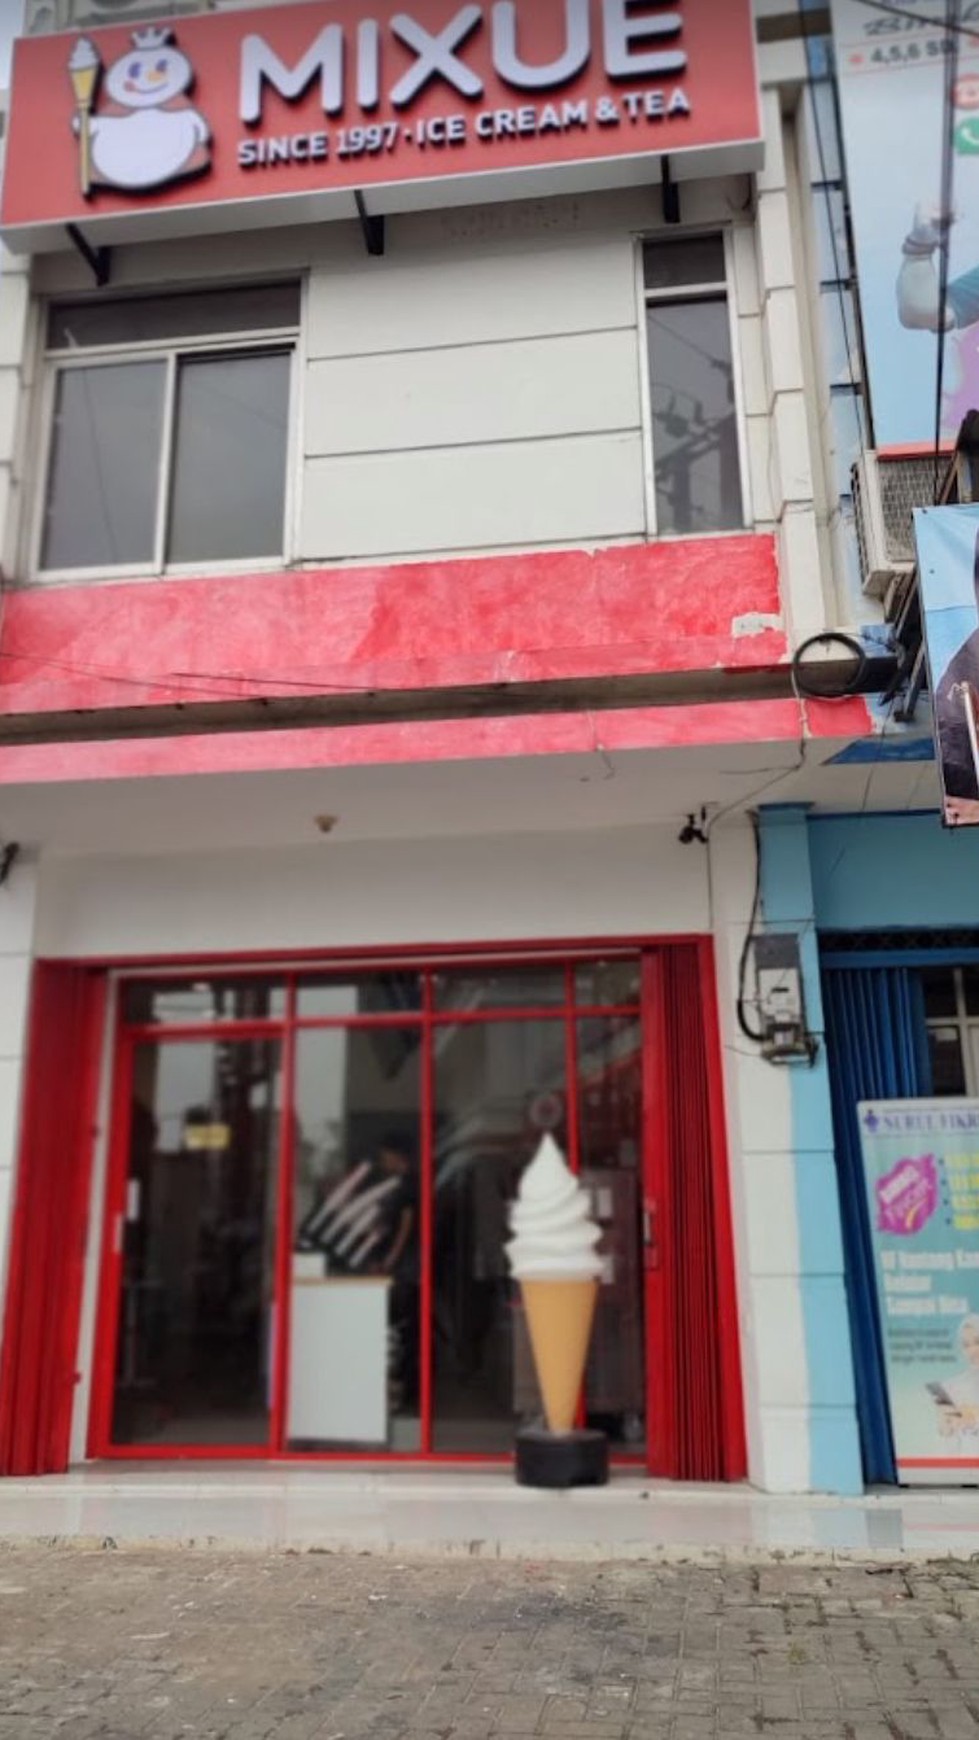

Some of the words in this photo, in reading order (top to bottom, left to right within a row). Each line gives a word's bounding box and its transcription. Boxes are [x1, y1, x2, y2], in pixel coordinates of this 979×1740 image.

[240, 0, 687, 122] MIXUE
[238, 131, 329, 166] SINCE
[336, 121, 398, 154] 1997
[416, 114, 465, 144] ICE
[475, 100, 588, 137] CREAM
[595, 96, 620, 122] &
[621, 87, 691, 118] TEA
